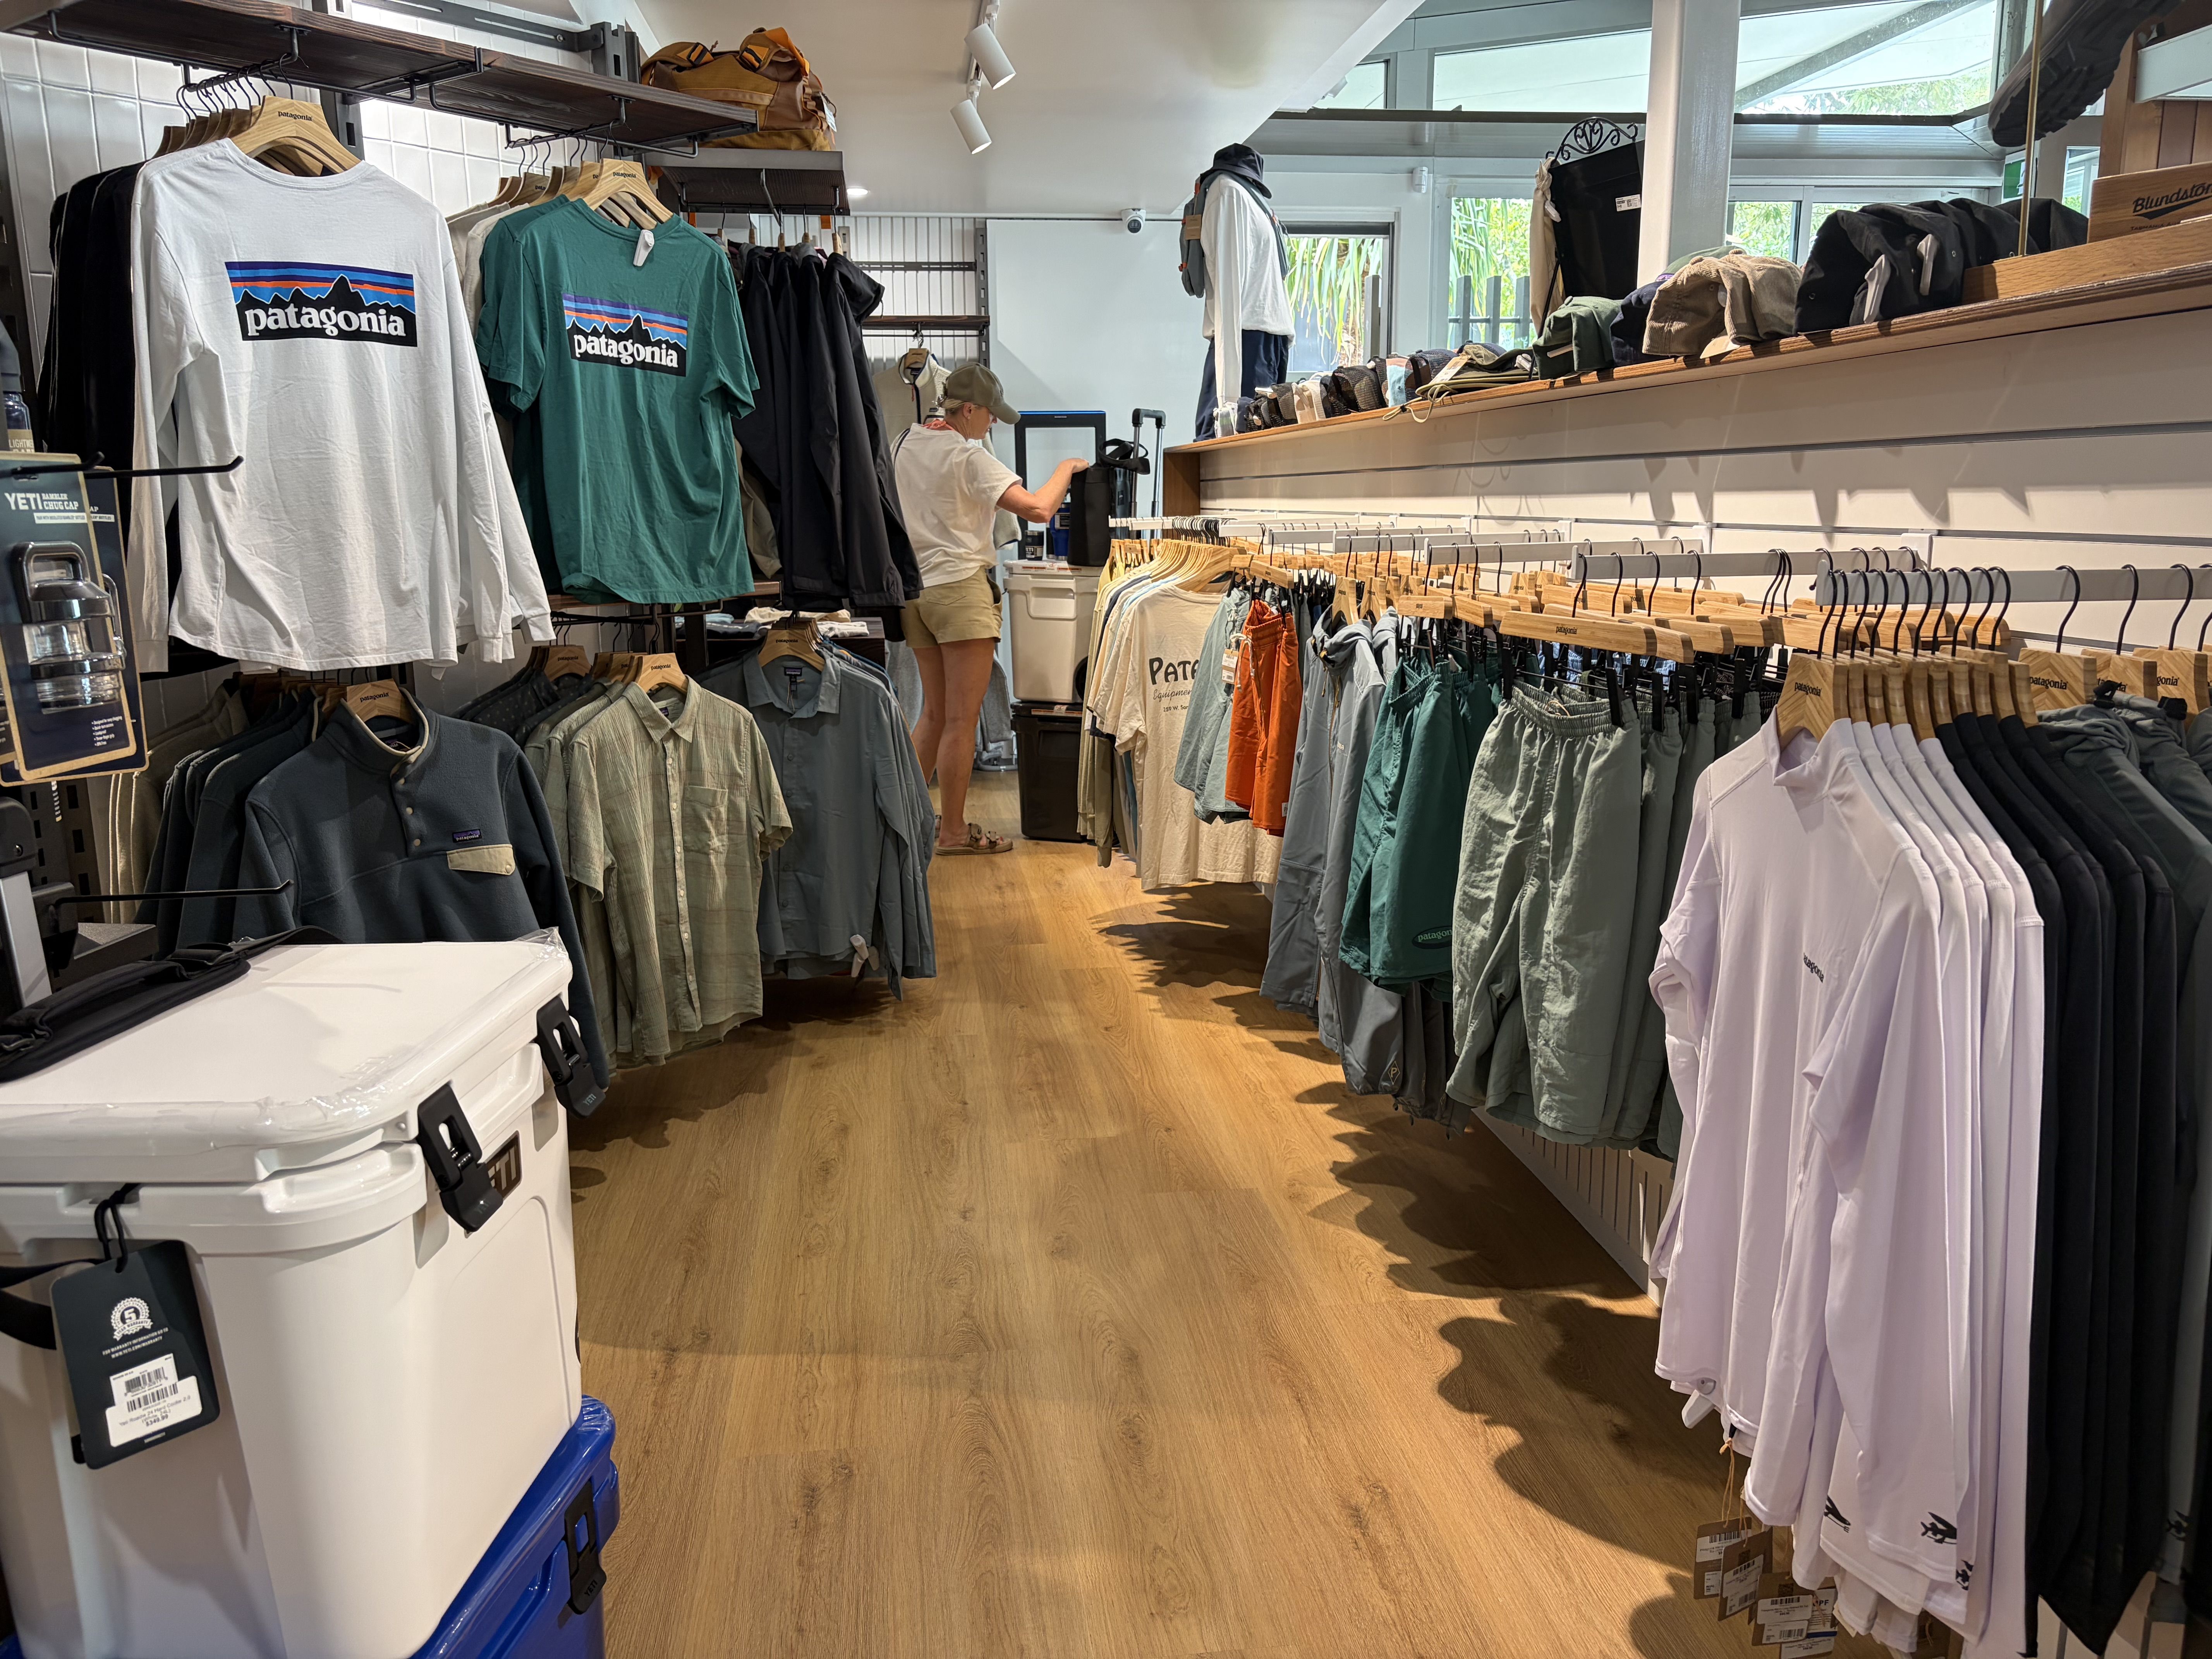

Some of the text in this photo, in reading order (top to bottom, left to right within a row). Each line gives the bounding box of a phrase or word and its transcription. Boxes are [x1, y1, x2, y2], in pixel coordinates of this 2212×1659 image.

[2133, 182, 2212, 213] Blundston
[245, 303, 406, 337] patagonia
[574, 334, 678, 368] patagonia
[4, 493, 43, 510] YETI
[44, 501, 79, 510] CHUG CAP
[1149, 657, 1199, 685] PATA
[1795, 682, 1822, 696] patagonia
[2157, 677, 2179, 686] gonia
[360, 692, 389, 702] patagonia
[1418, 929, 1452, 942] patagon
[583, 1094, 596, 1106] YETI
[488, 1146, 516, 1190] TI
[124, 1308, 136, 1322] 5
[584, 1579, 597, 1596] YETI
